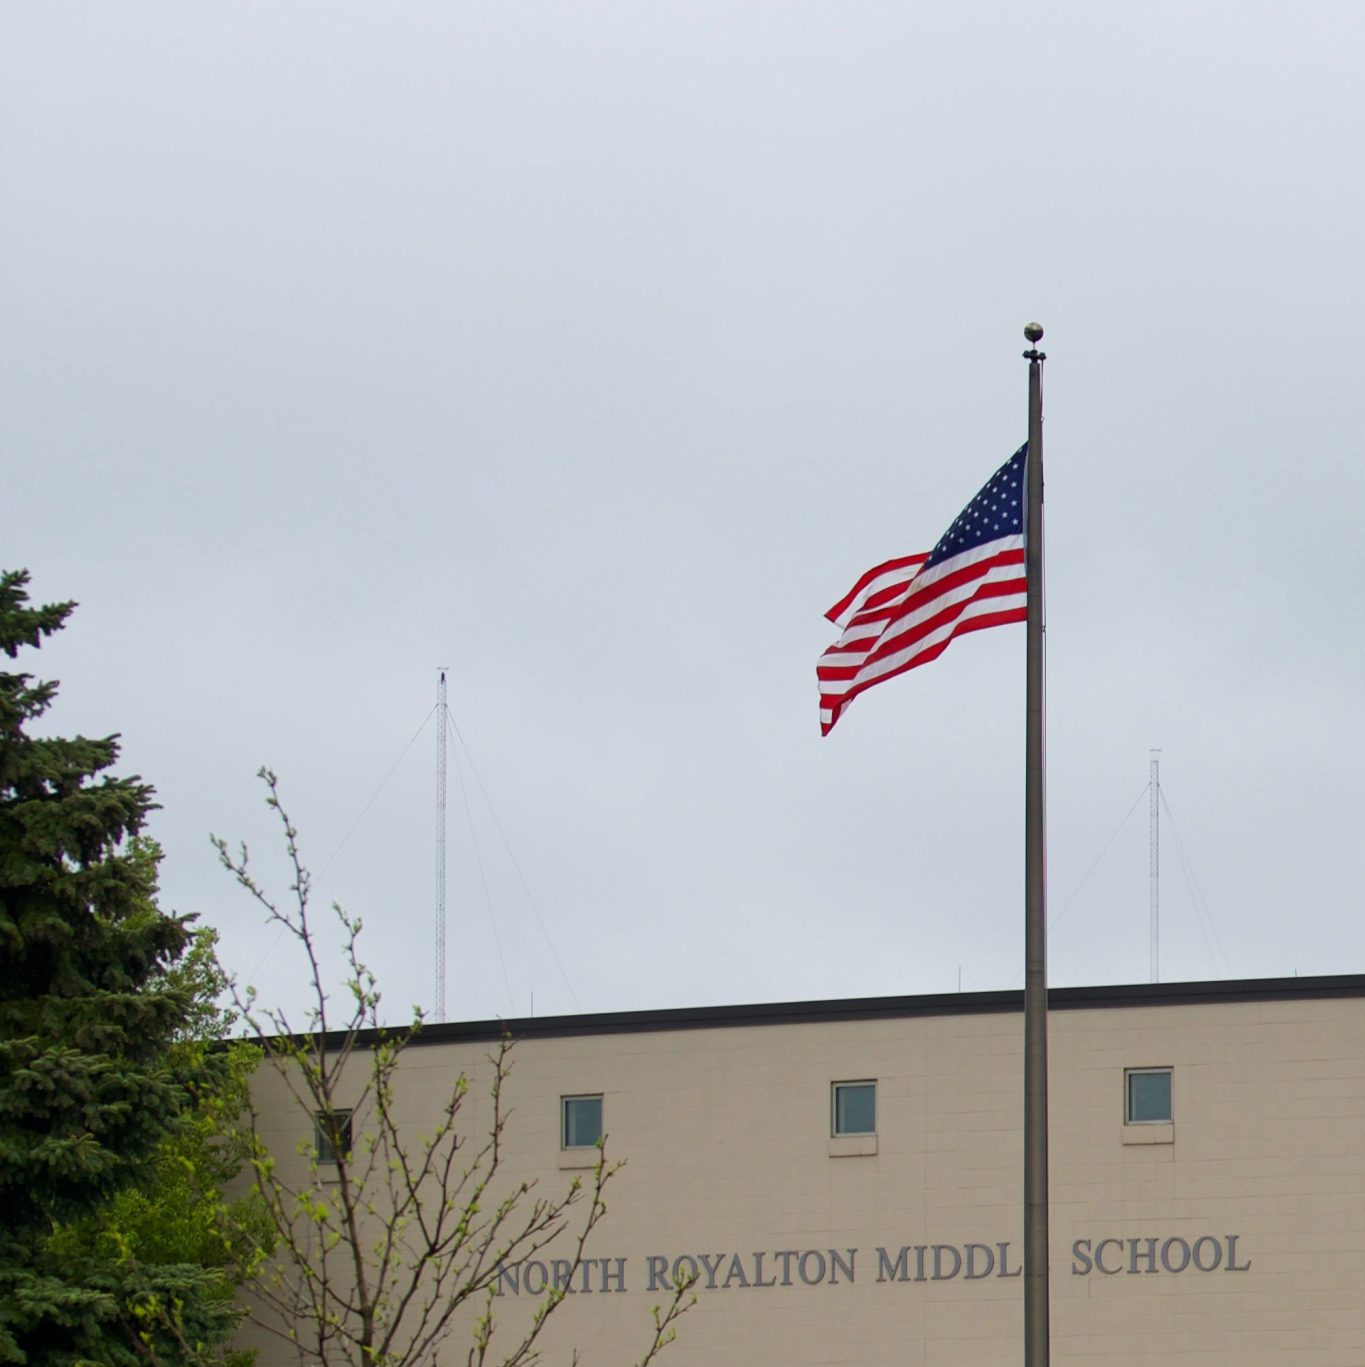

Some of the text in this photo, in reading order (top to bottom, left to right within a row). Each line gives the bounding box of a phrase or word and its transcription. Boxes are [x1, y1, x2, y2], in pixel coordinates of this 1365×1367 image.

[496, 1234, 1252, 1297] NORTH ROYALTON MIDDL SCHOOL
